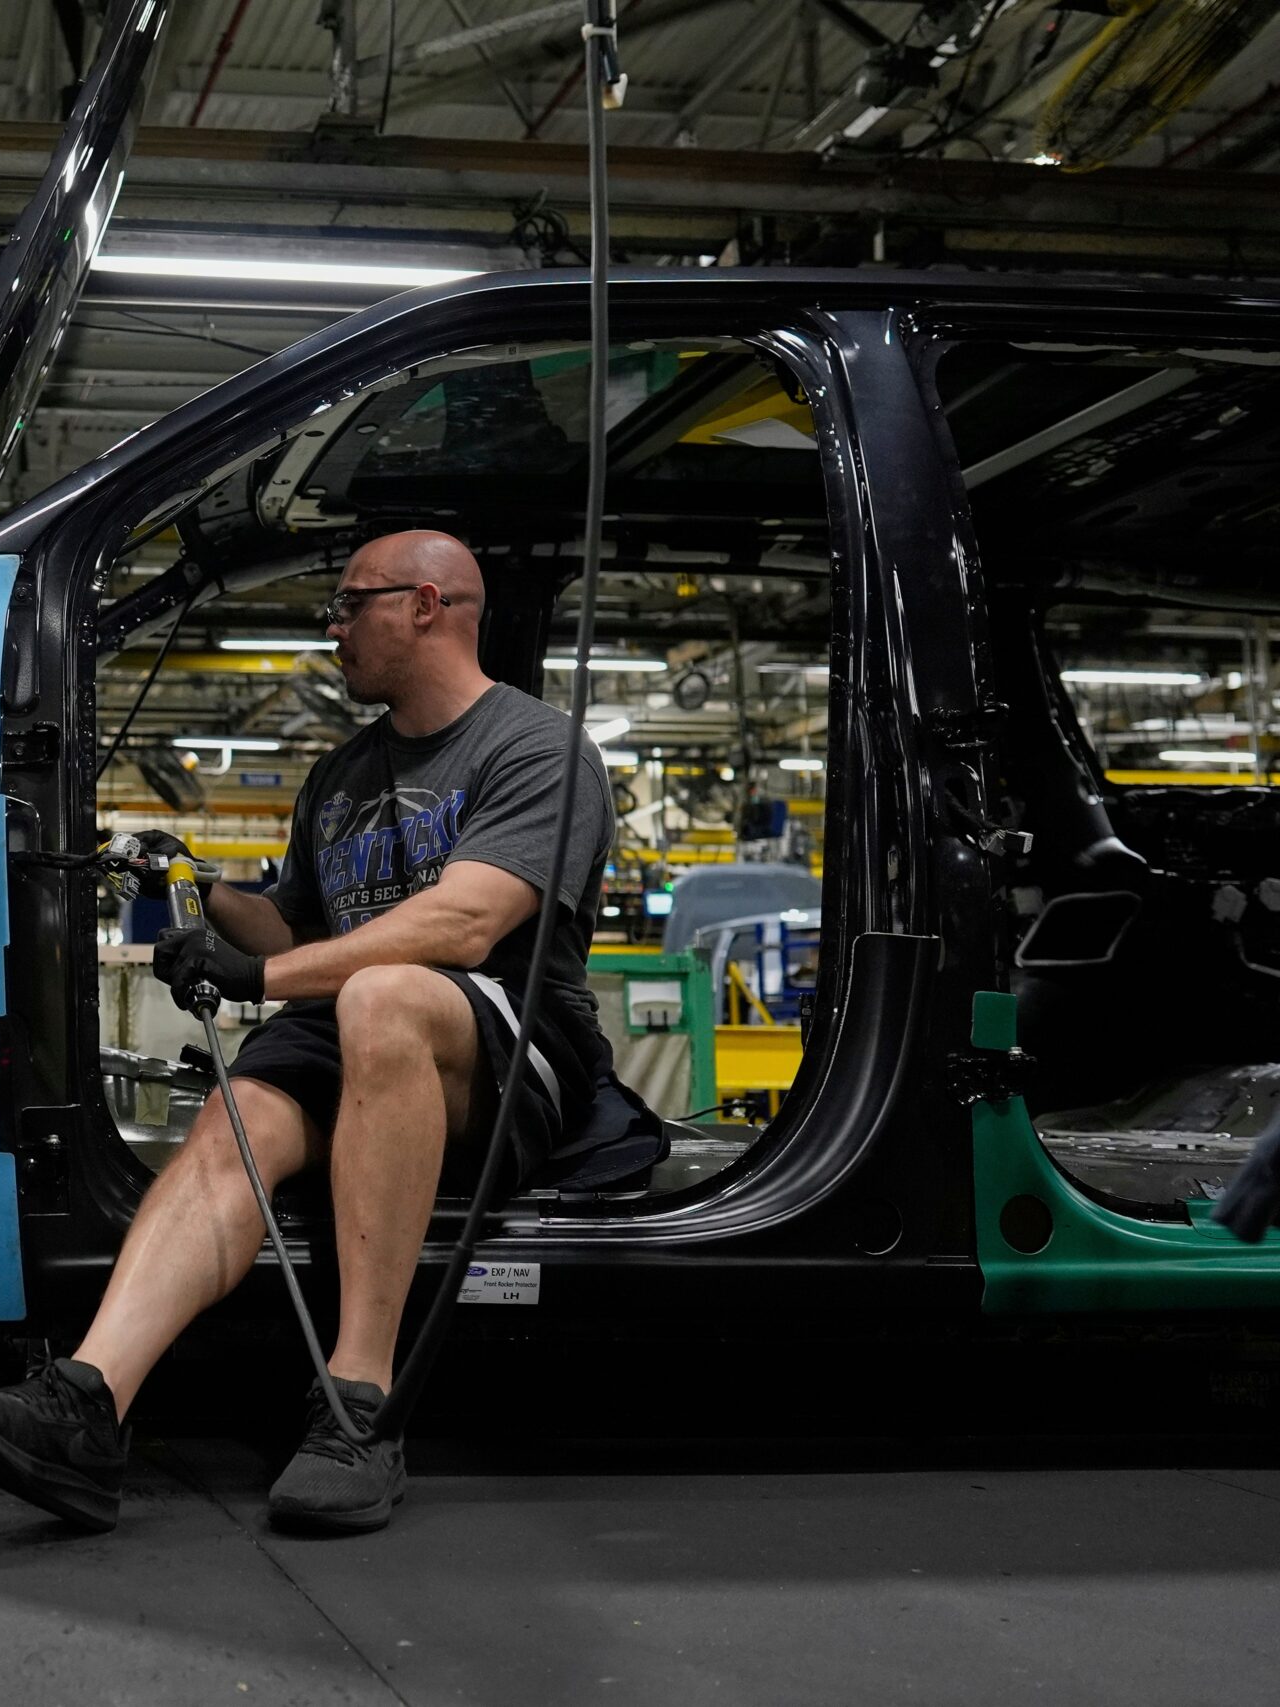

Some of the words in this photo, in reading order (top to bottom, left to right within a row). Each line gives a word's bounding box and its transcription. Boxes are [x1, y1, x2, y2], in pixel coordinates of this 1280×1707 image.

[491, 1267, 506, 1277] EXP
[507, 1267, 512, 1278] /
[513, 1268, 530, 1277] NAV
[503, 1292, 520, 1300] LH
